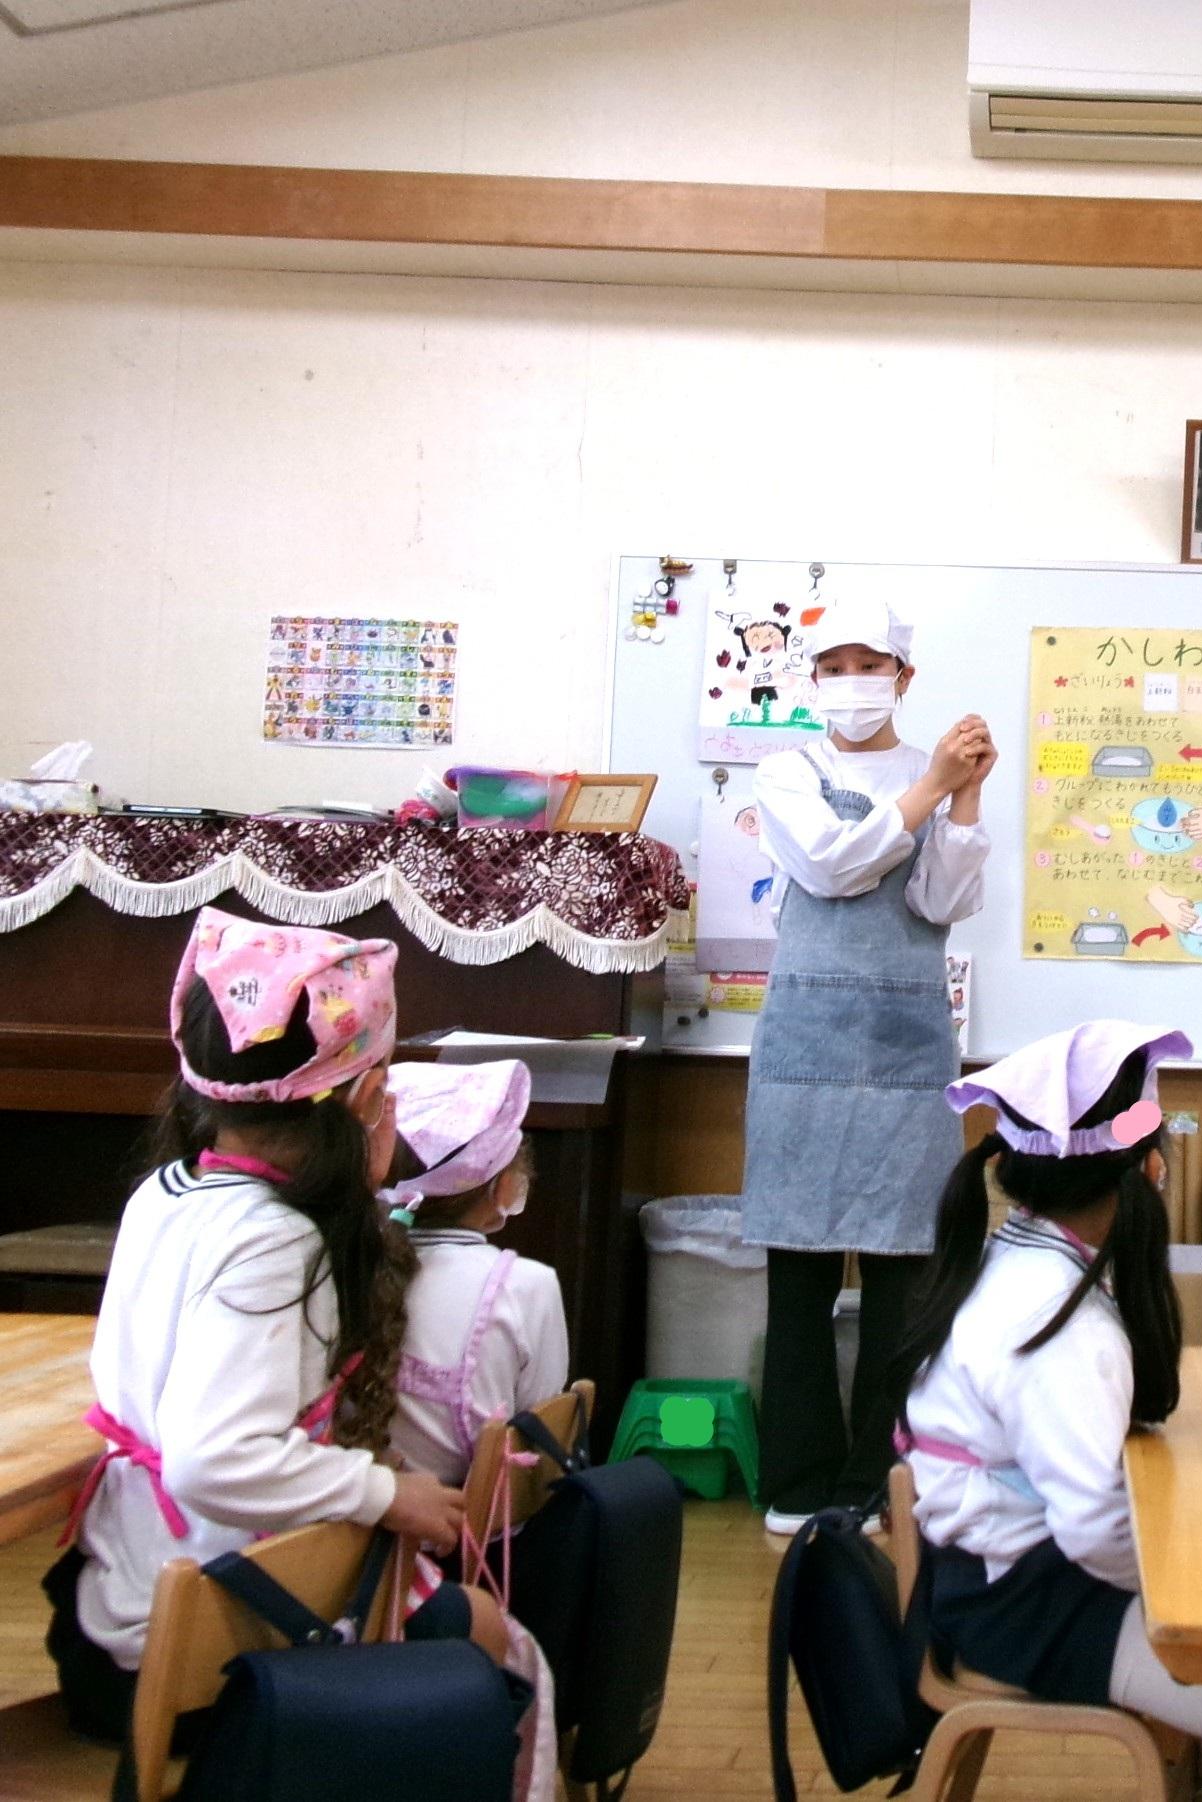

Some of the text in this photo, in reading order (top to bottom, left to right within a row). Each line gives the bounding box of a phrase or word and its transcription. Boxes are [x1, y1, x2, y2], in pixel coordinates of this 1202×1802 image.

[1070, 672, 1122, 689] ざいりょう
